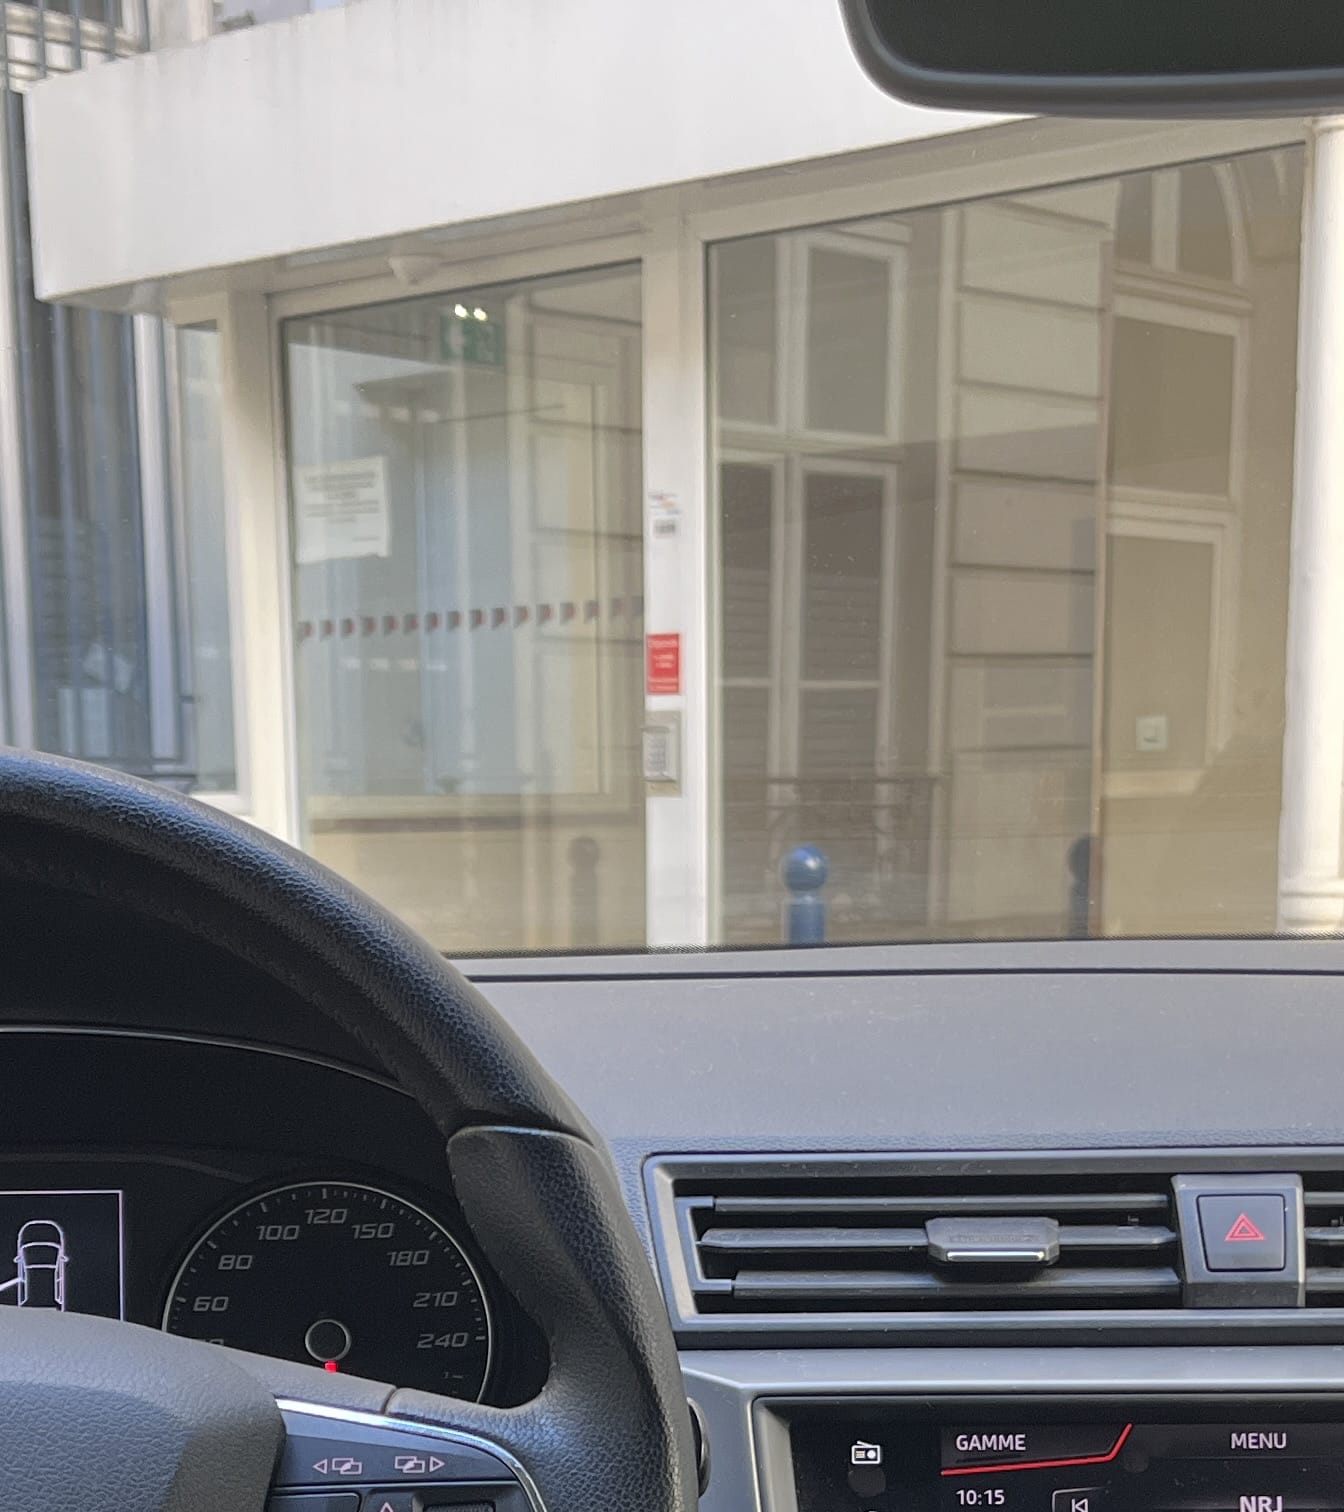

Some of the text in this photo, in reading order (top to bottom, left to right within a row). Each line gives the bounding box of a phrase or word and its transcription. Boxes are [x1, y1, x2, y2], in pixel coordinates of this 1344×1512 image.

[305, 1208, 348, 1224] 120
[256, 1225, 300, 1241] 100
[351, 1223, 394, 1239] 150
[218, 1255, 253, 1270] 80
[386, 1250, 430, 1267] 180
[192, 1296, 229, 1312] 60
[412, 1291, 457, 1308] 210
[417, 1332, 468, 1349] 240
[956, 1434, 1026, 1451] GAMME
[1231, 1432, 1287, 1449] MENU
[956, 1489, 1005, 1505] 10:15
